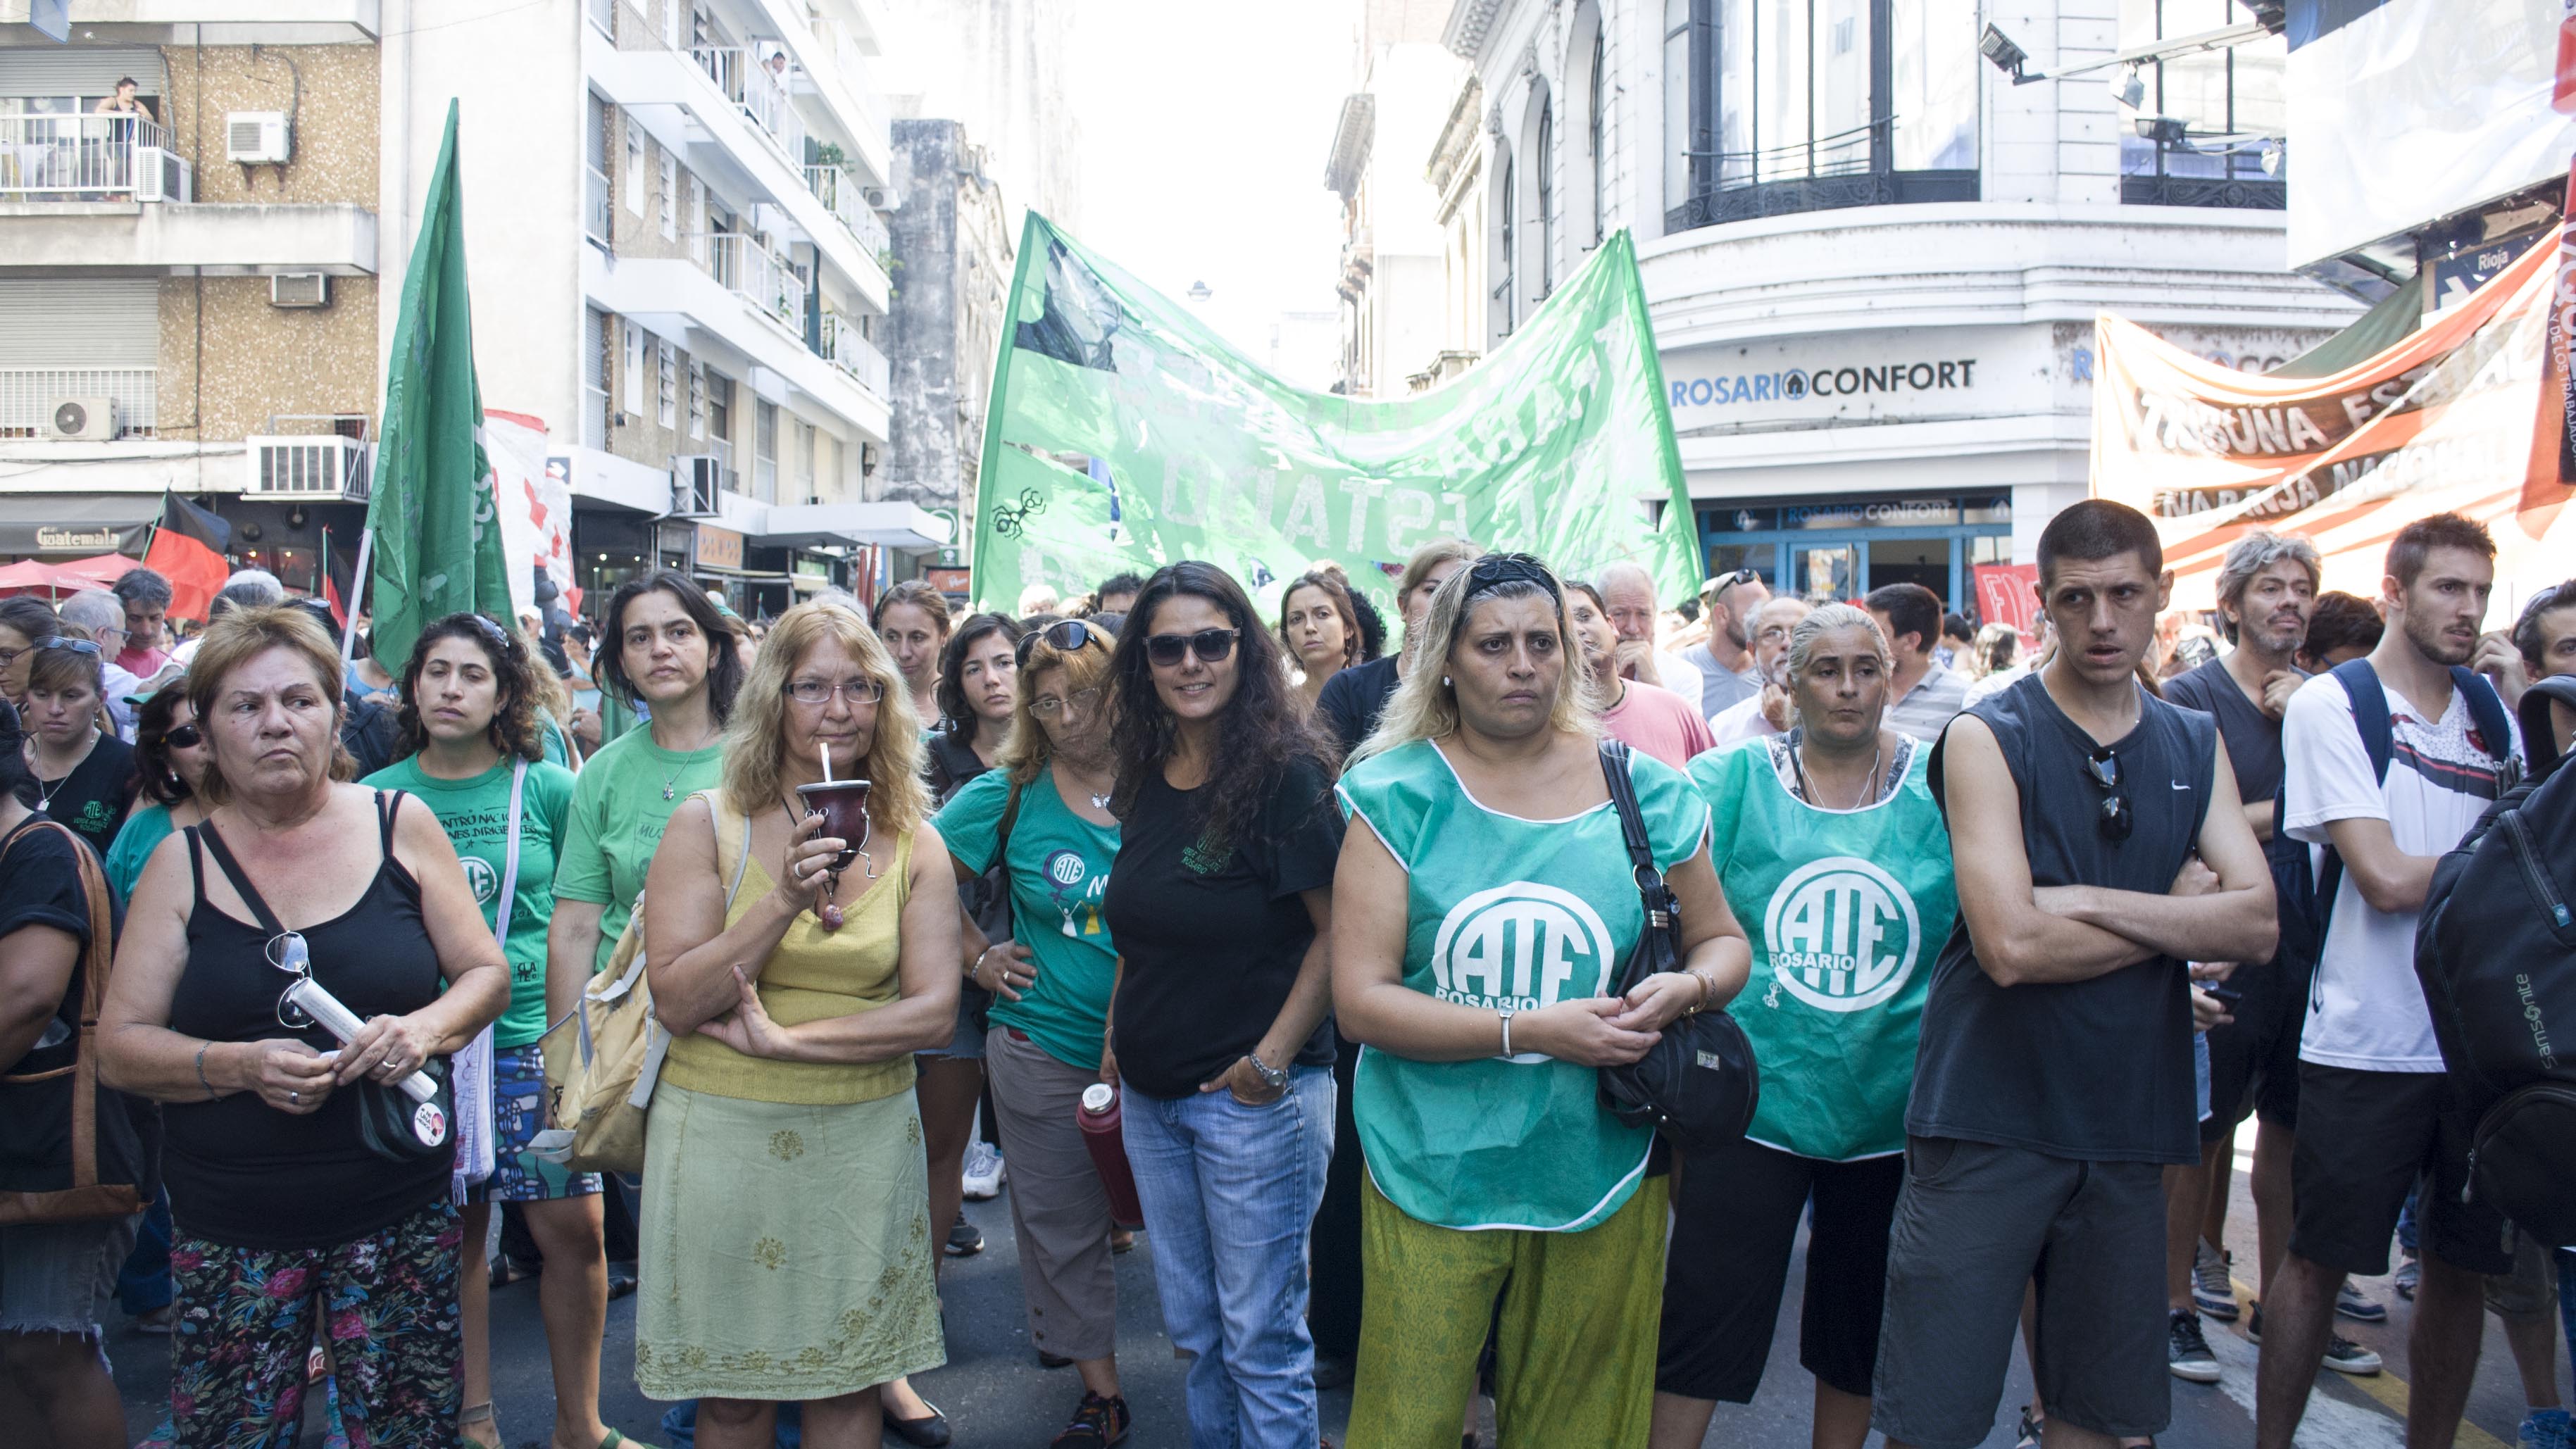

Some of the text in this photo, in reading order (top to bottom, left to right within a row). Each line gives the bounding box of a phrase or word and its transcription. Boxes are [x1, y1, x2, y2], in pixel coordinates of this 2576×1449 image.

[2478, 249, 2508, 270] Rioja
[2549, 325, 2563, 344] DE
[2553, 346, 2568, 373] LOS
[1672, 359, 1976, 407] ROSARIO CONFORT
[1865, 501, 1945, 521] CONFORT
[439, 814, 477, 829] NTRO
[473, 824, 537, 837] DIRIGETES
[1056, 856, 1082, 882] ATE
[1781, 873, 1899, 995] ATE
[1768, 951, 1856, 972] ROSARIO
